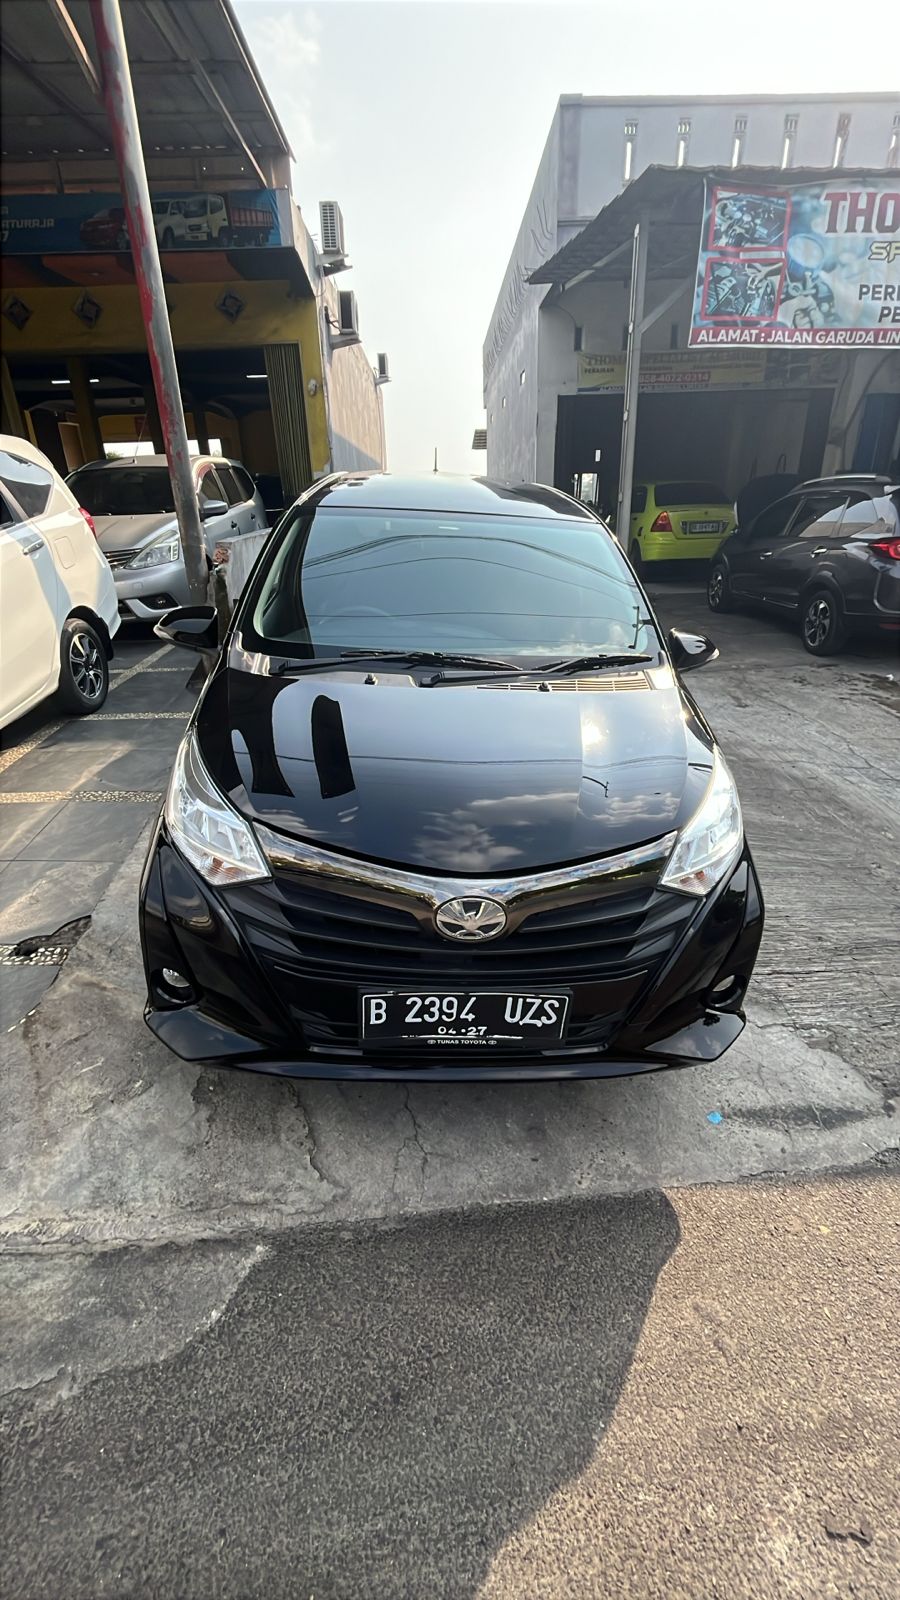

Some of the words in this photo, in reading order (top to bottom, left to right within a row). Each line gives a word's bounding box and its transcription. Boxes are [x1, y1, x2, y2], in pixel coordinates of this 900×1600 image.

[697, 329, 759, 343] ALAMAT
[767, 331, 812, 343] JALAN
[815, 331, 874, 344] GARUDA
[370, 998, 387, 1024] B
[404, 996, 477, 1023] 2394
[504, 997, 560, 1026] UZS
